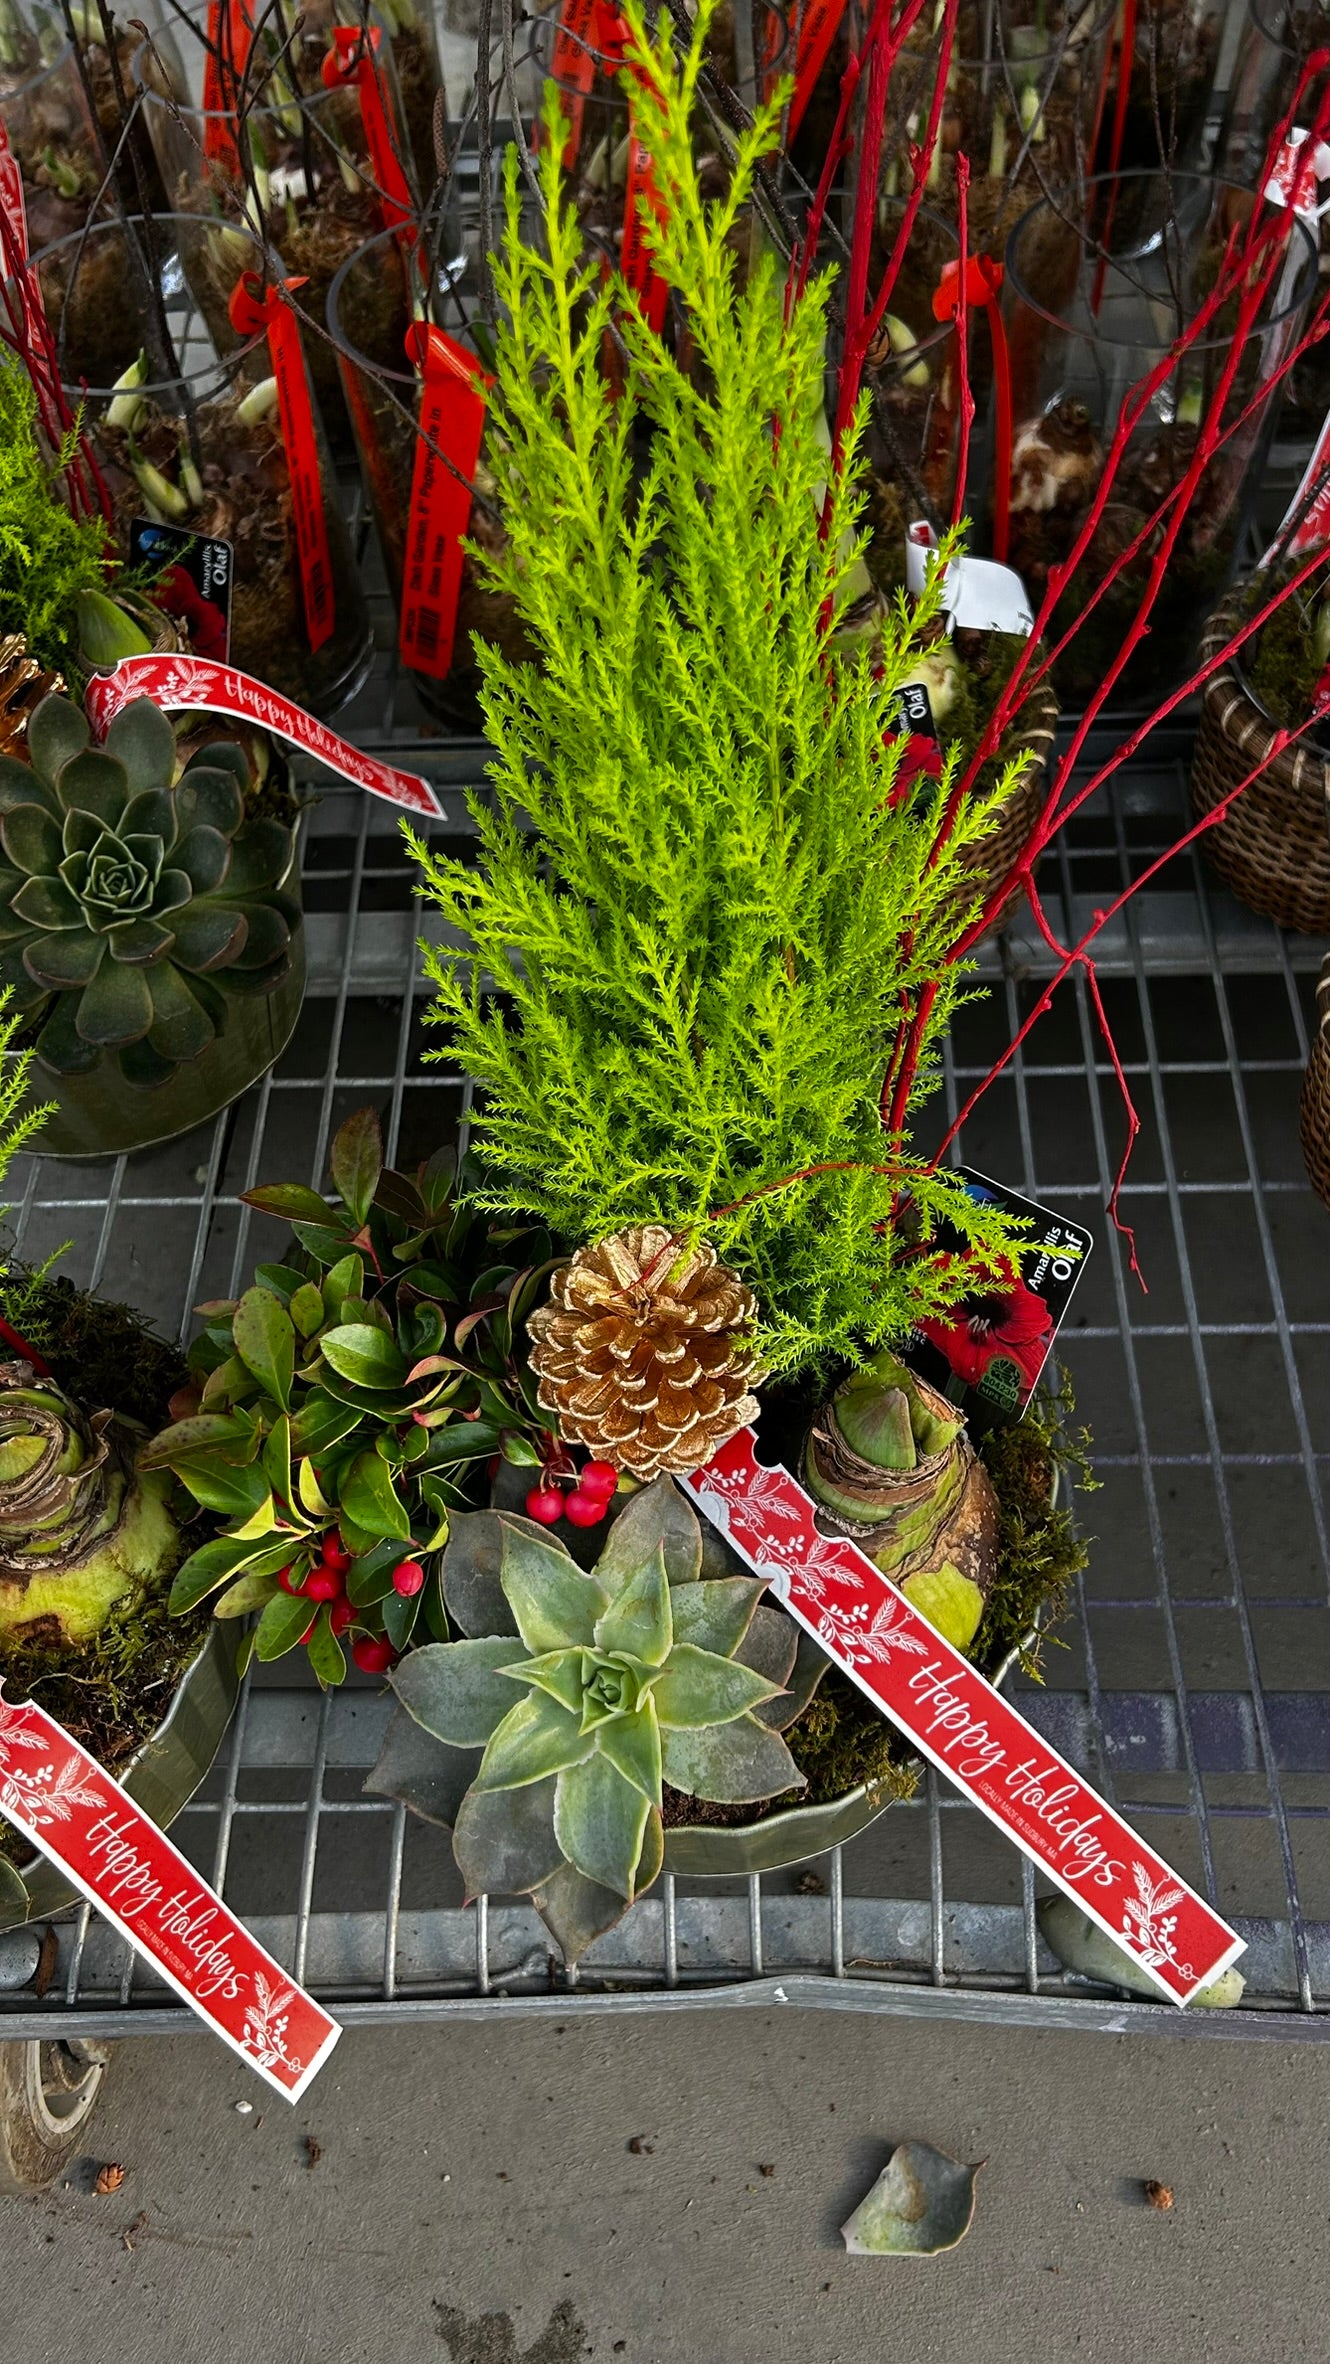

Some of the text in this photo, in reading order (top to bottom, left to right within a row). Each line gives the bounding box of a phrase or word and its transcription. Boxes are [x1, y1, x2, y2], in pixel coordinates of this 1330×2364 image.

[201, 543, 213, 599] Amaryllis
[212, 543, 229, 586] Olaf
[225, 675, 295, 737] Happy
[296, 714, 375, 782] Holidays
[904, 689, 928, 719] Olaf
[1028, 1226, 1062, 1292] Amarllis
[908, 1661, 1127, 1887] Happy Holidays
[978, 1780, 1003, 1804] LOCALLY
[1001, 1801, 1020, 1820] MADE
[1016, 1816, 1025, 1827] IN
[1045, 1846, 1058, 1860] MA
[85, 1811, 250, 1999] Happy Holidays
